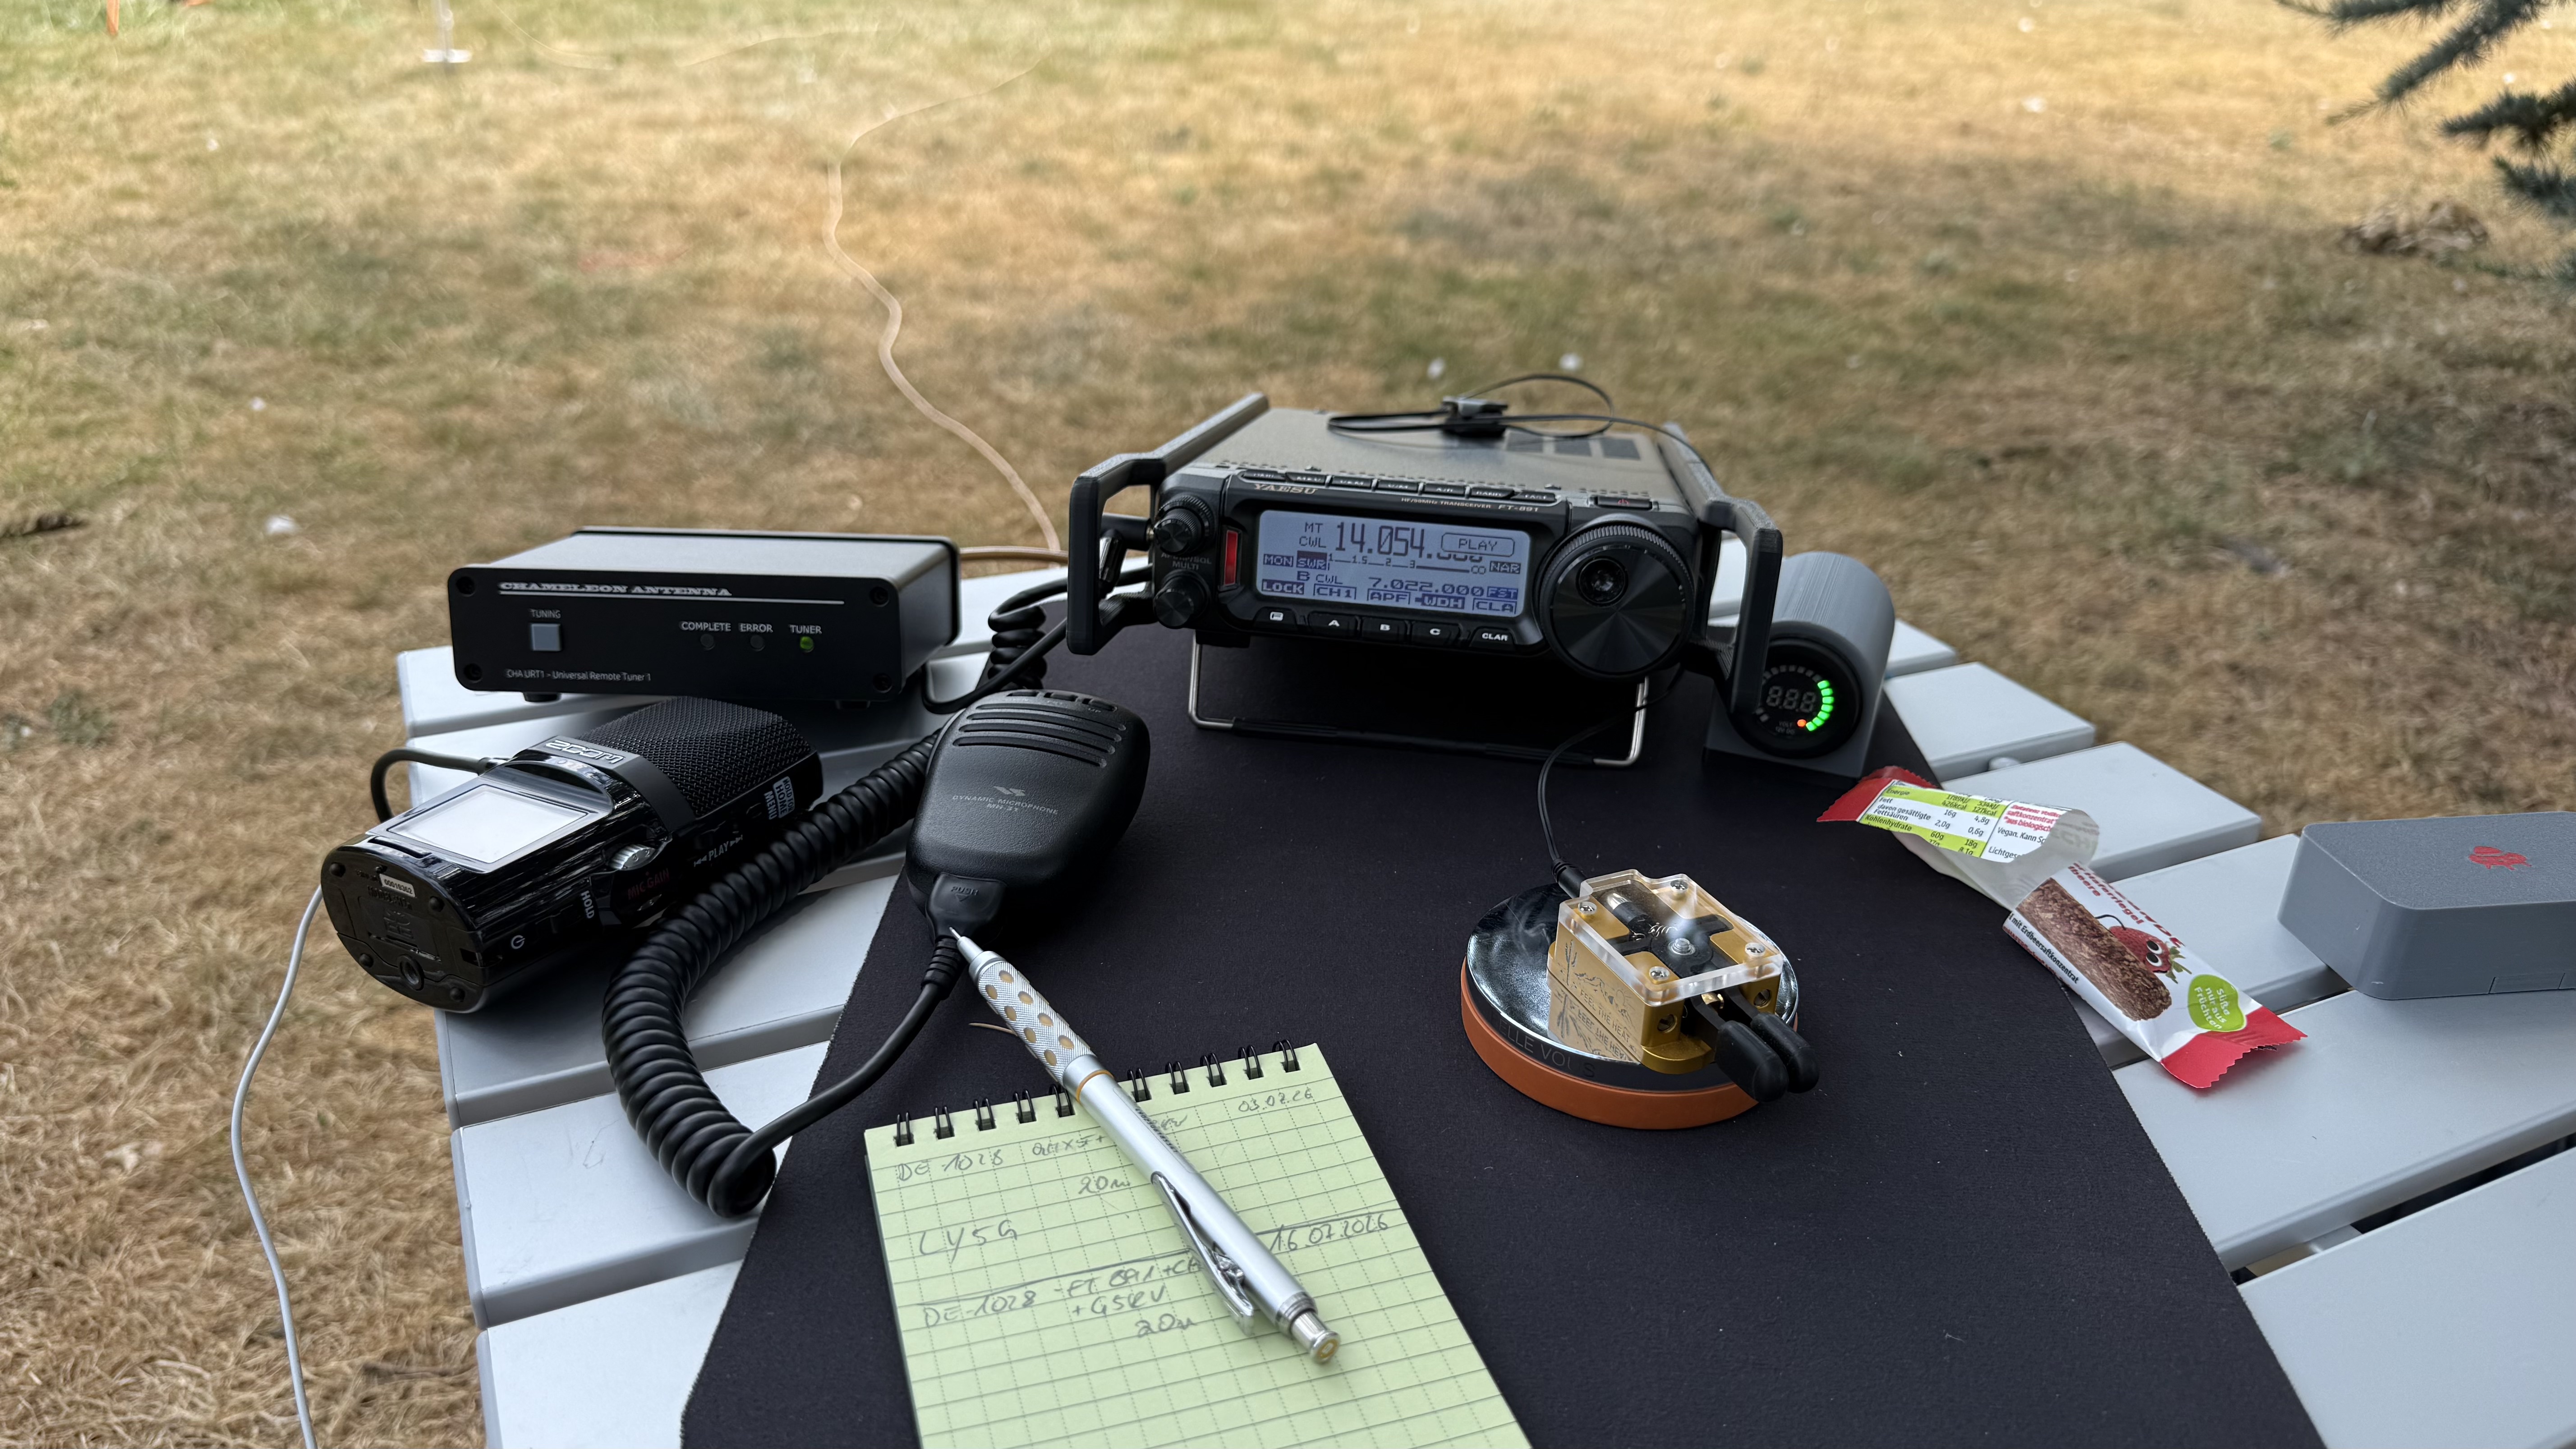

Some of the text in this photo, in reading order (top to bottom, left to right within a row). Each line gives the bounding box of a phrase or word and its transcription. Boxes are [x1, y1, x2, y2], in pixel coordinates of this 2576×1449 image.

[1254, 483, 1318, 495] YAESU
[1440, 500, 1491, 509] TRANSCEIVER
[1498, 504, 1539, 512] FT-891
[1304, 522, 1323, 534] MT
[1298, 536, 1327, 548] CWL
[1335, 521, 1497, 563] 14.054. PLAY
[1172, 561, 1199, 570] MULTI
[1264, 554, 1293, 567] MON
[1297, 557, 1326, 570] SWR
[1490, 561, 1521, 574] NAR
[498, 581, 732, 597] CHAMELEON ANTENNA
[1262, 580, 1304, 594] LOCK
[1370, 592, 1408, 603] APF
[1316, 574, 1343, 585] CWL
[1368, 577, 1484, 597] 7.022.000
[1488, 587, 1518, 599] FST
[529, 608, 561, 619] TUNING
[680, 621, 731, 632] COMPLETE
[738, 622, 773, 633] ERROR
[788, 624, 823, 635] TUNER
[1429, 628, 1441, 636] C
[1481, 632, 1509, 642] CLAR
[506, 668, 525, 679] CHA
[552, 670, 589, 681] Universal
[590, 671, 621, 681] Remote
[621, 671, 645, 682] Tuner
[545, 739, 626, 764] ZOOM
[764, 791, 777, 820] MENU
[775, 784, 787, 814] HOME
[998, 799, 1059, 814] MICROPHONE
[1877, 804, 1932, 821] davon gesättigte
[1944, 810, 1957, 818] 16g
[1974, 815, 1990, 825] 4,8g
[1865, 815, 1912, 832] Kohlenhydrate
[1930, 831, 1944, 841] 60g
[1964, 839, 1978, 848] 18g
[1934, 819, 1951, 829] 2,0g
[1968, 827, 1984, 837] 0,6g
[1997, 827, 2018, 838] Vegan.
[2019, 832, 2037, 842] Kann
[708, 841, 730, 861] PLAY
[647, 868, 670, 889] GAIN
[950, 885, 979, 896] PUSH
[2082, 868, 2145, 925] Haferriegel
[581, 890, 595, 919] HOLD
[2013, 916, 2022, 930] mit
[2021, 925, 2079, 984] Erdbeersaftkonzentrat
[2194, 986, 2223, 1030] Früchten
[2205, 987, 2227, 1023] nur aus
[2216, 988, 2231, 1016] Süße
[1580, 989, 1631, 1043] FEEL THE HEAT
